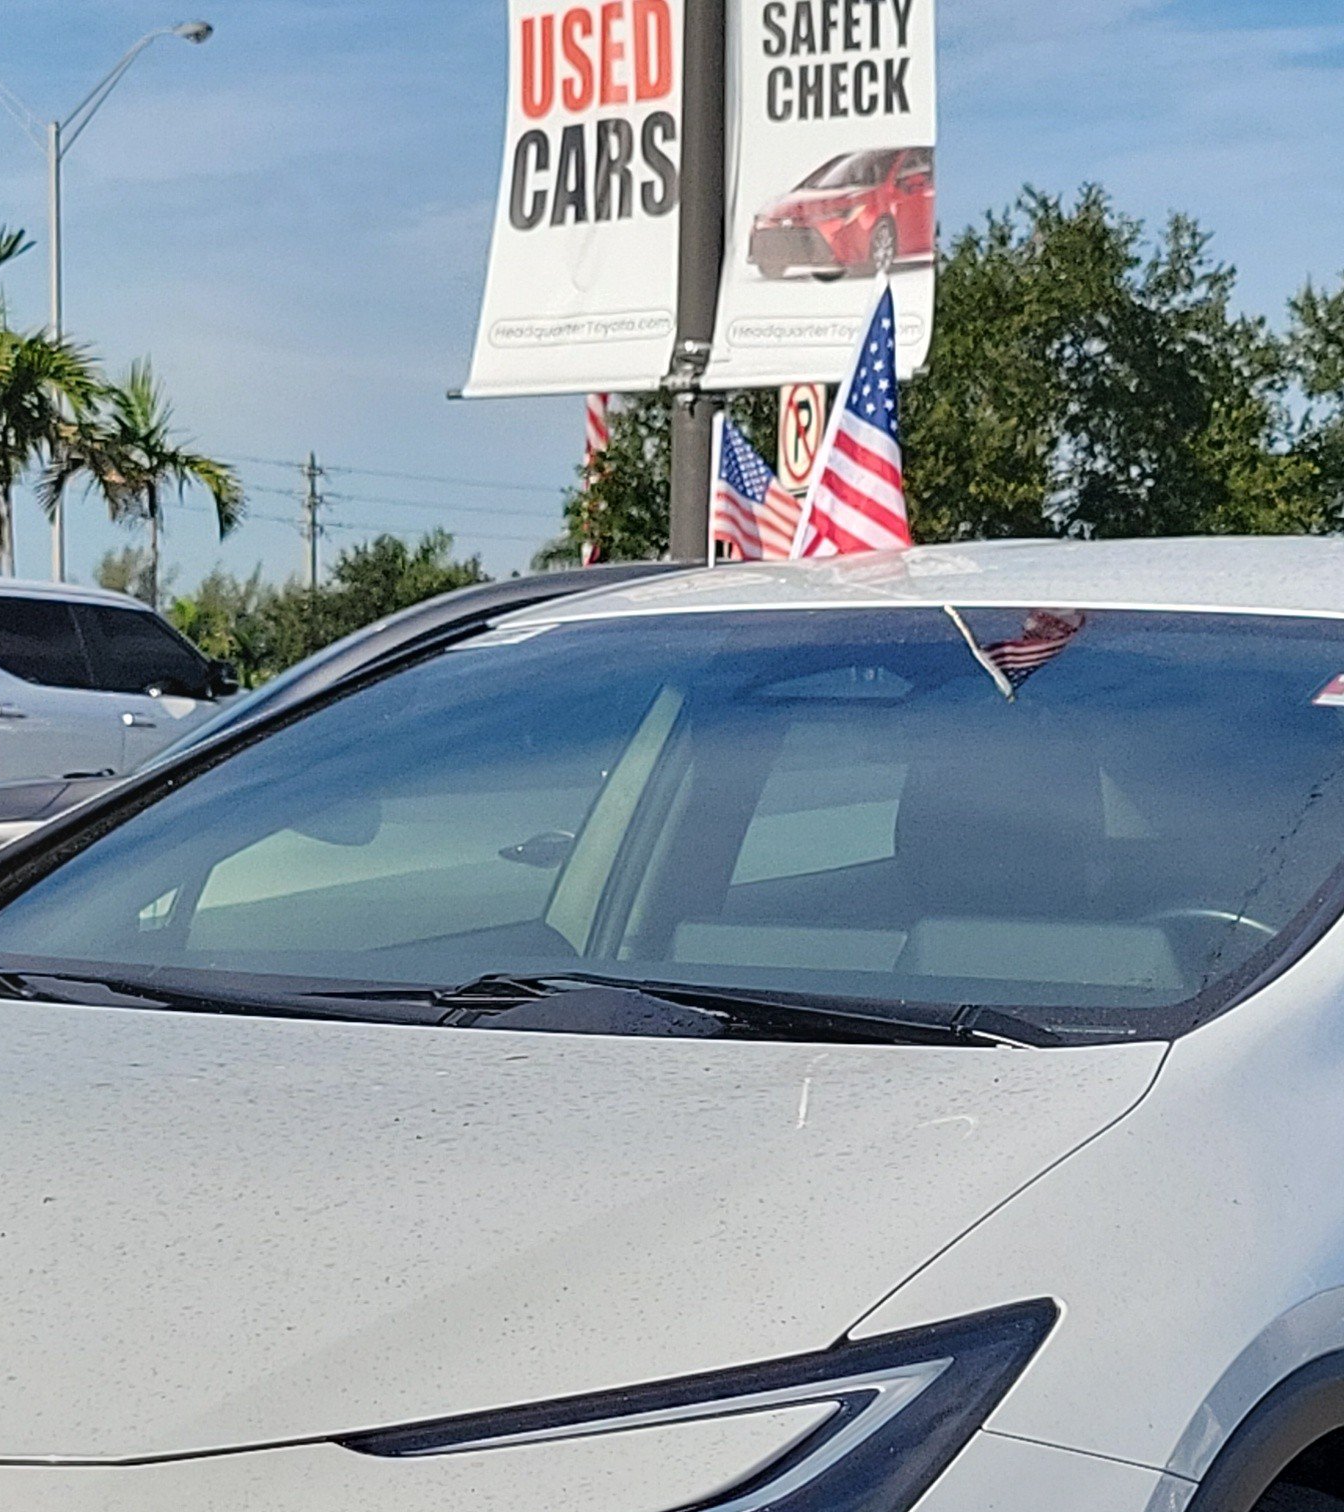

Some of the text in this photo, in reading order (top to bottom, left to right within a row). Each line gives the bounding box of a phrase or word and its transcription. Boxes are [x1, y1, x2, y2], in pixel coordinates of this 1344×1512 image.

[521, 0, 673, 119] USED
[762, 0, 913, 57] SAFETY
[766, 57, 911, 122] CHECK
[509, 110, 680, 232] CARS
